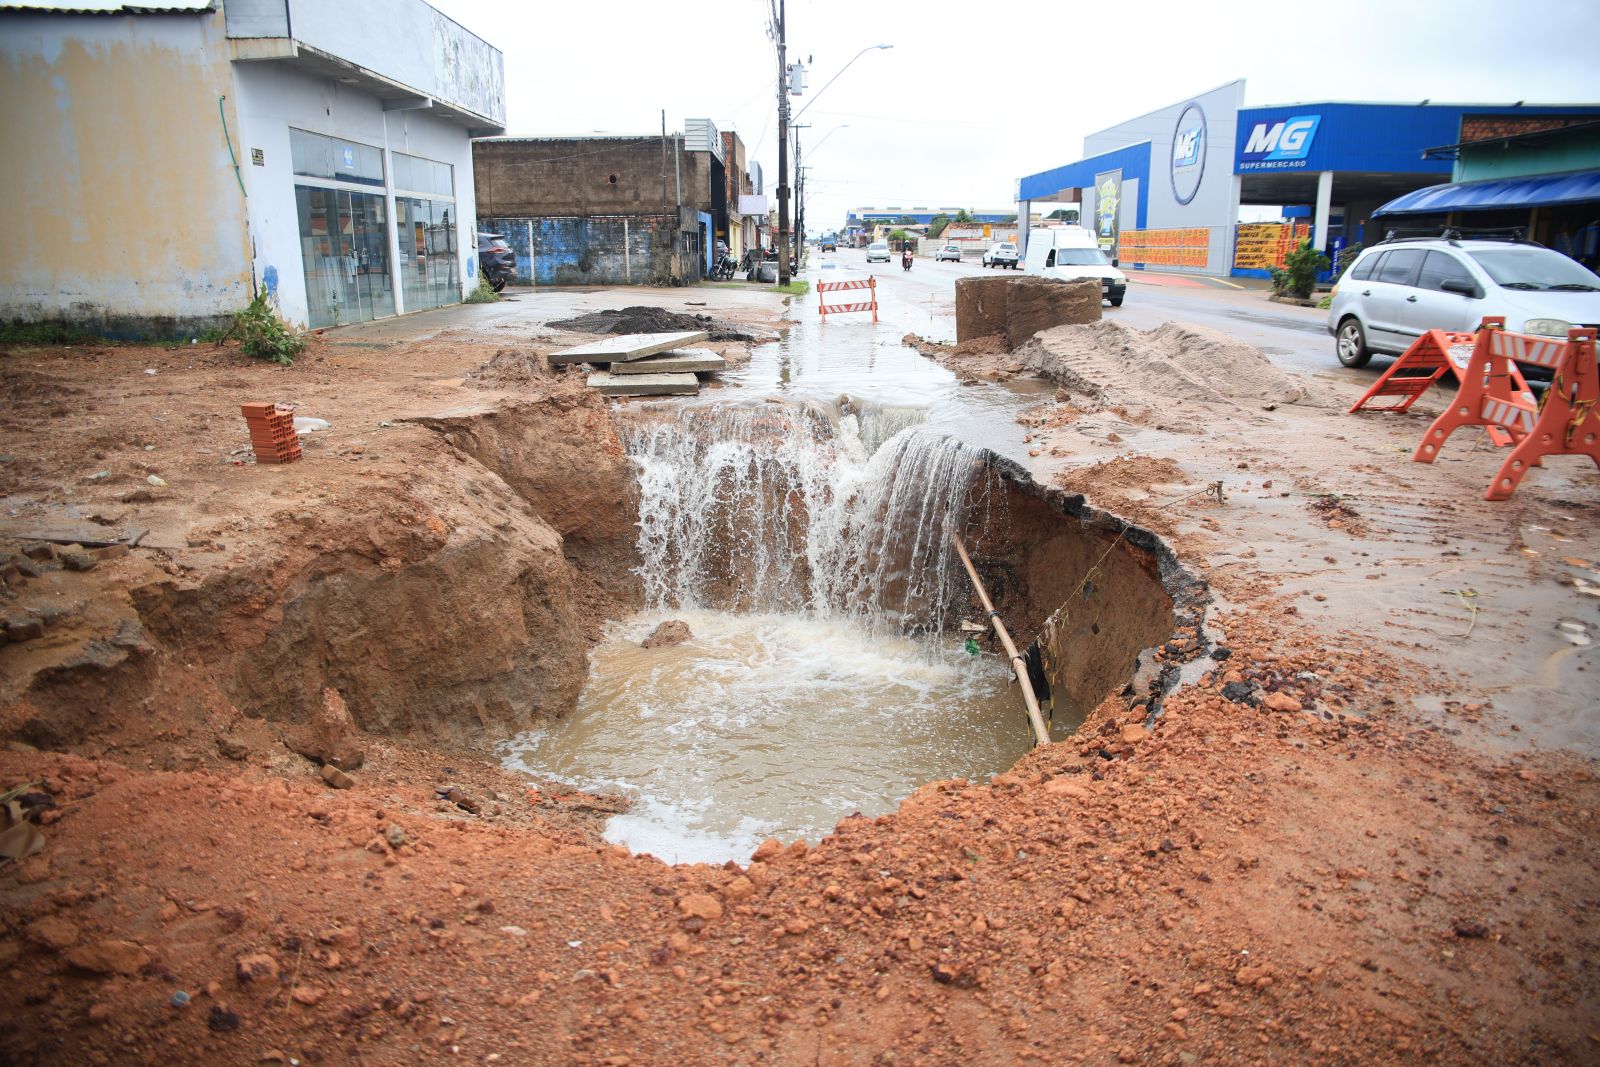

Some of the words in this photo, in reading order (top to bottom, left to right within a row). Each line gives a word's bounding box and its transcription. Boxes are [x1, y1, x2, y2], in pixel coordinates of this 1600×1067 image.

[1175, 130, 1198, 160] MG
[1243, 120, 1315, 154] MG
[1240, 161, 1307, 169] SUPERMERCADO
